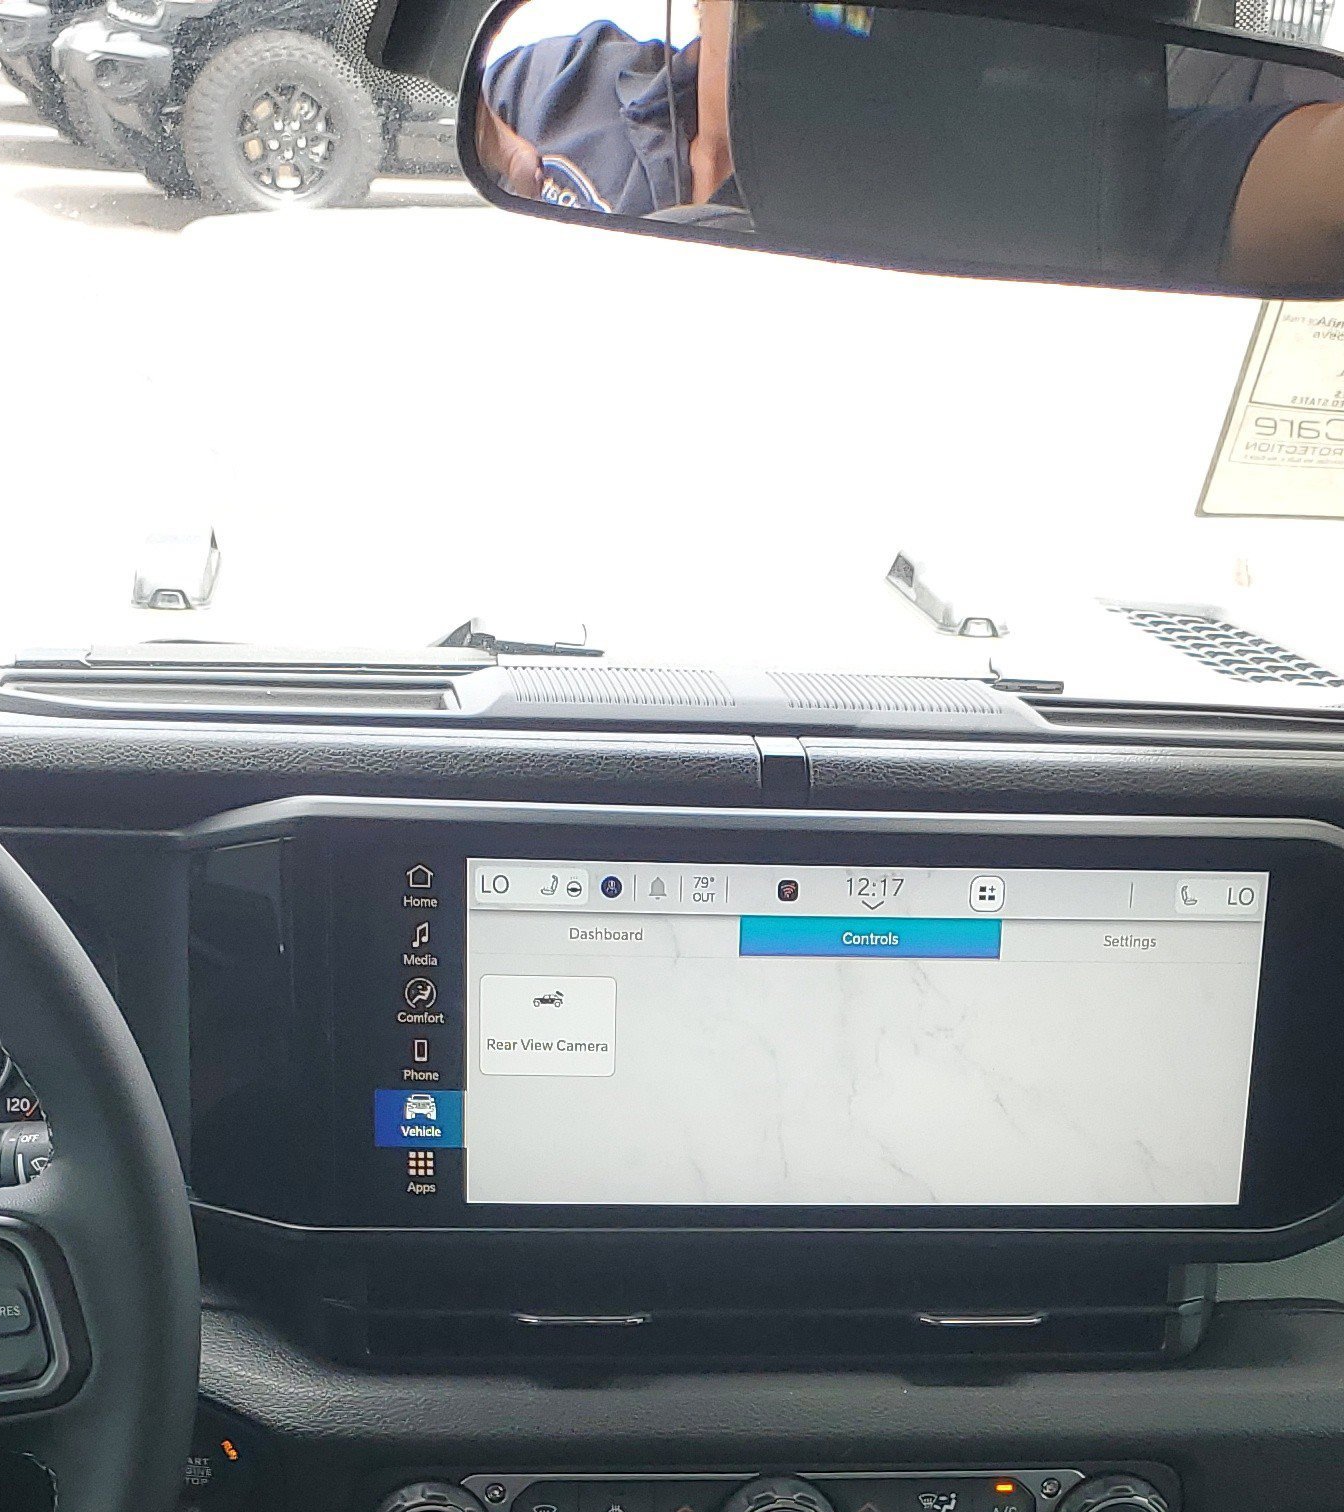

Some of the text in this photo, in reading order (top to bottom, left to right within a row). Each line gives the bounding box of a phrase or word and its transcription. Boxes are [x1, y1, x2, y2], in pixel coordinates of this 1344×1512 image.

[480, 874, 510, 896] LO
[692, 876, 716, 891] 79°
[845, 877, 906, 899] 12:17
[402, 894, 439, 910] Home
[691, 891, 716, 904] OUT
[1226, 886, 1256, 907] LO
[568, 926, 645, 943] Dashboard
[841, 930, 900, 948] Controls
[1102, 933, 1158, 952] Settings
[402, 953, 439, 968] Media
[397, 1009, 445, 1025] Comfort
[486, 1038, 609, 1055] Rear View Camera
[402, 1068, 440, 1083] Phone
[5, 1097, 31, 1114] 120
[20, 1133, 40, 1144] OFF
[400, 1125, 442, 1139] Vehicle
[406, 1181, 437, 1195] Apps
